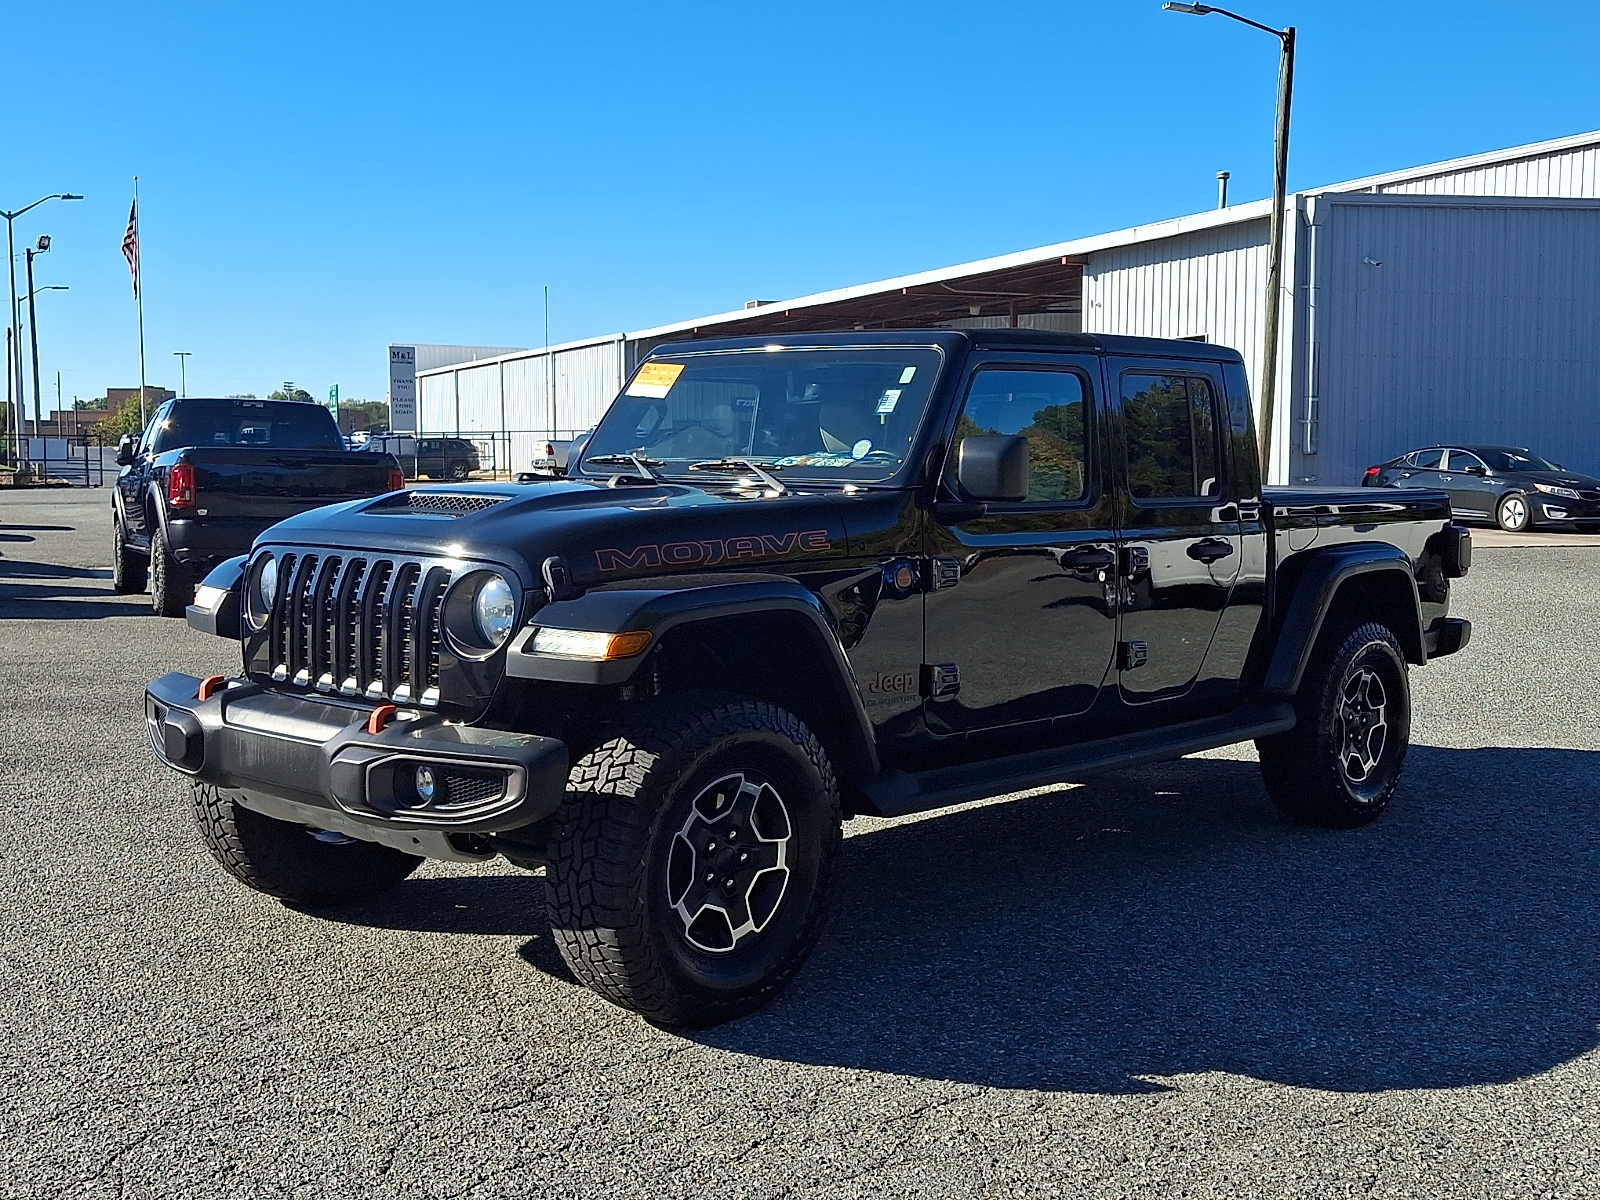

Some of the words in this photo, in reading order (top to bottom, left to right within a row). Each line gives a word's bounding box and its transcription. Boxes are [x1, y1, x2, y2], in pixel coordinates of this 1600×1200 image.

[392, 351, 413, 360] M&L
[595, 529, 831, 572] MOJAVE
[868, 671, 914, 694] Jeep
